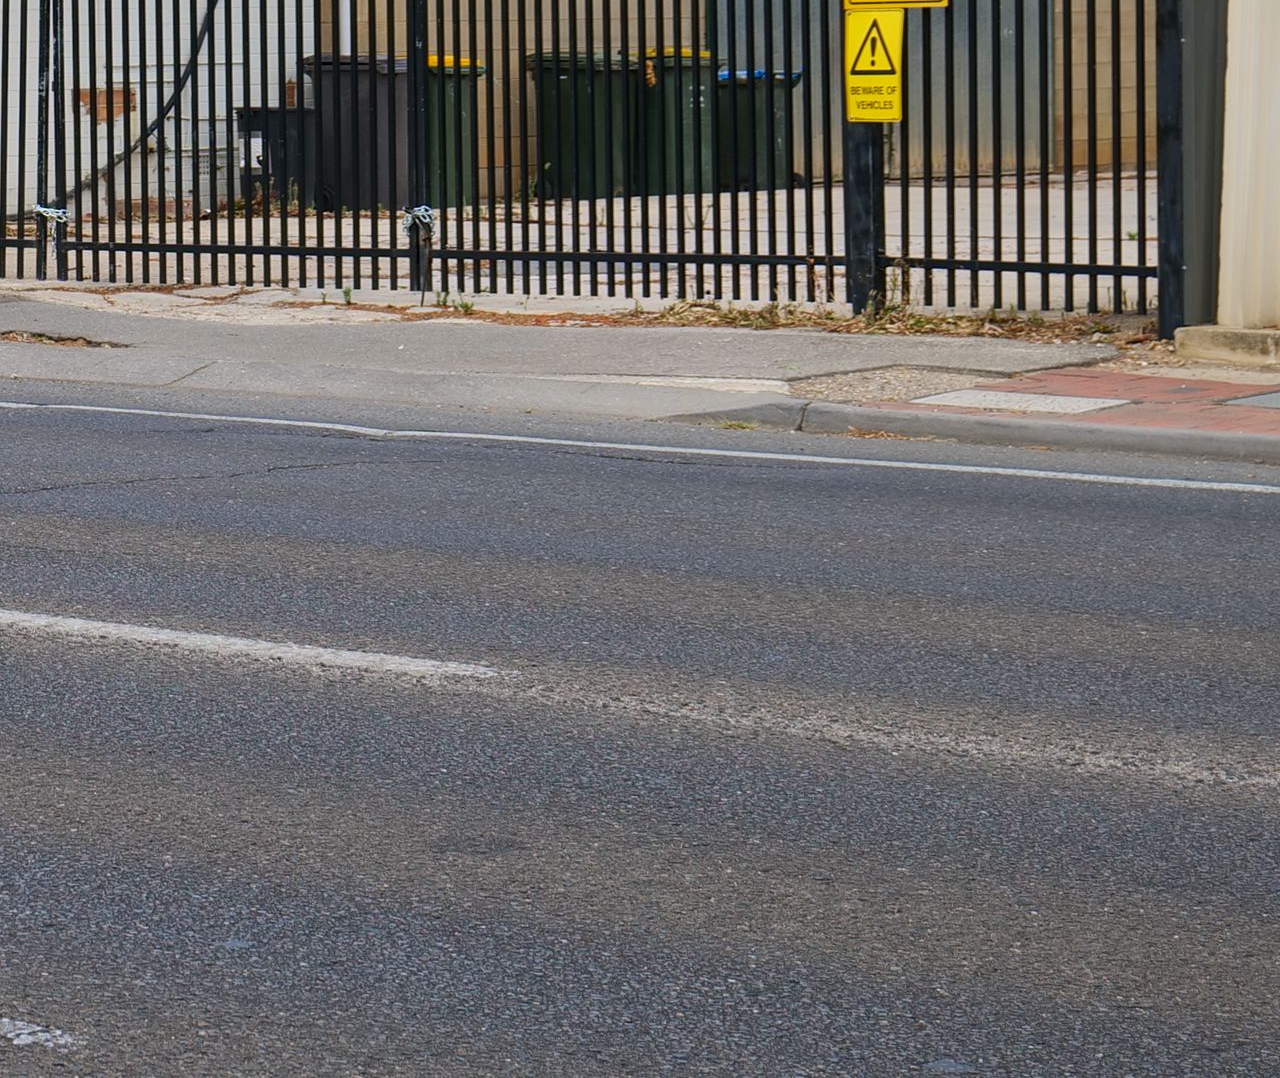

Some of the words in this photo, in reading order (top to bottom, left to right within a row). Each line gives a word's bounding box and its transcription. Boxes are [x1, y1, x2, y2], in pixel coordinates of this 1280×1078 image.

[851, 86, 884, 96] BEWARE
[886, 85, 897, 95] OF
[856, 100, 894, 110] VEHICLES
